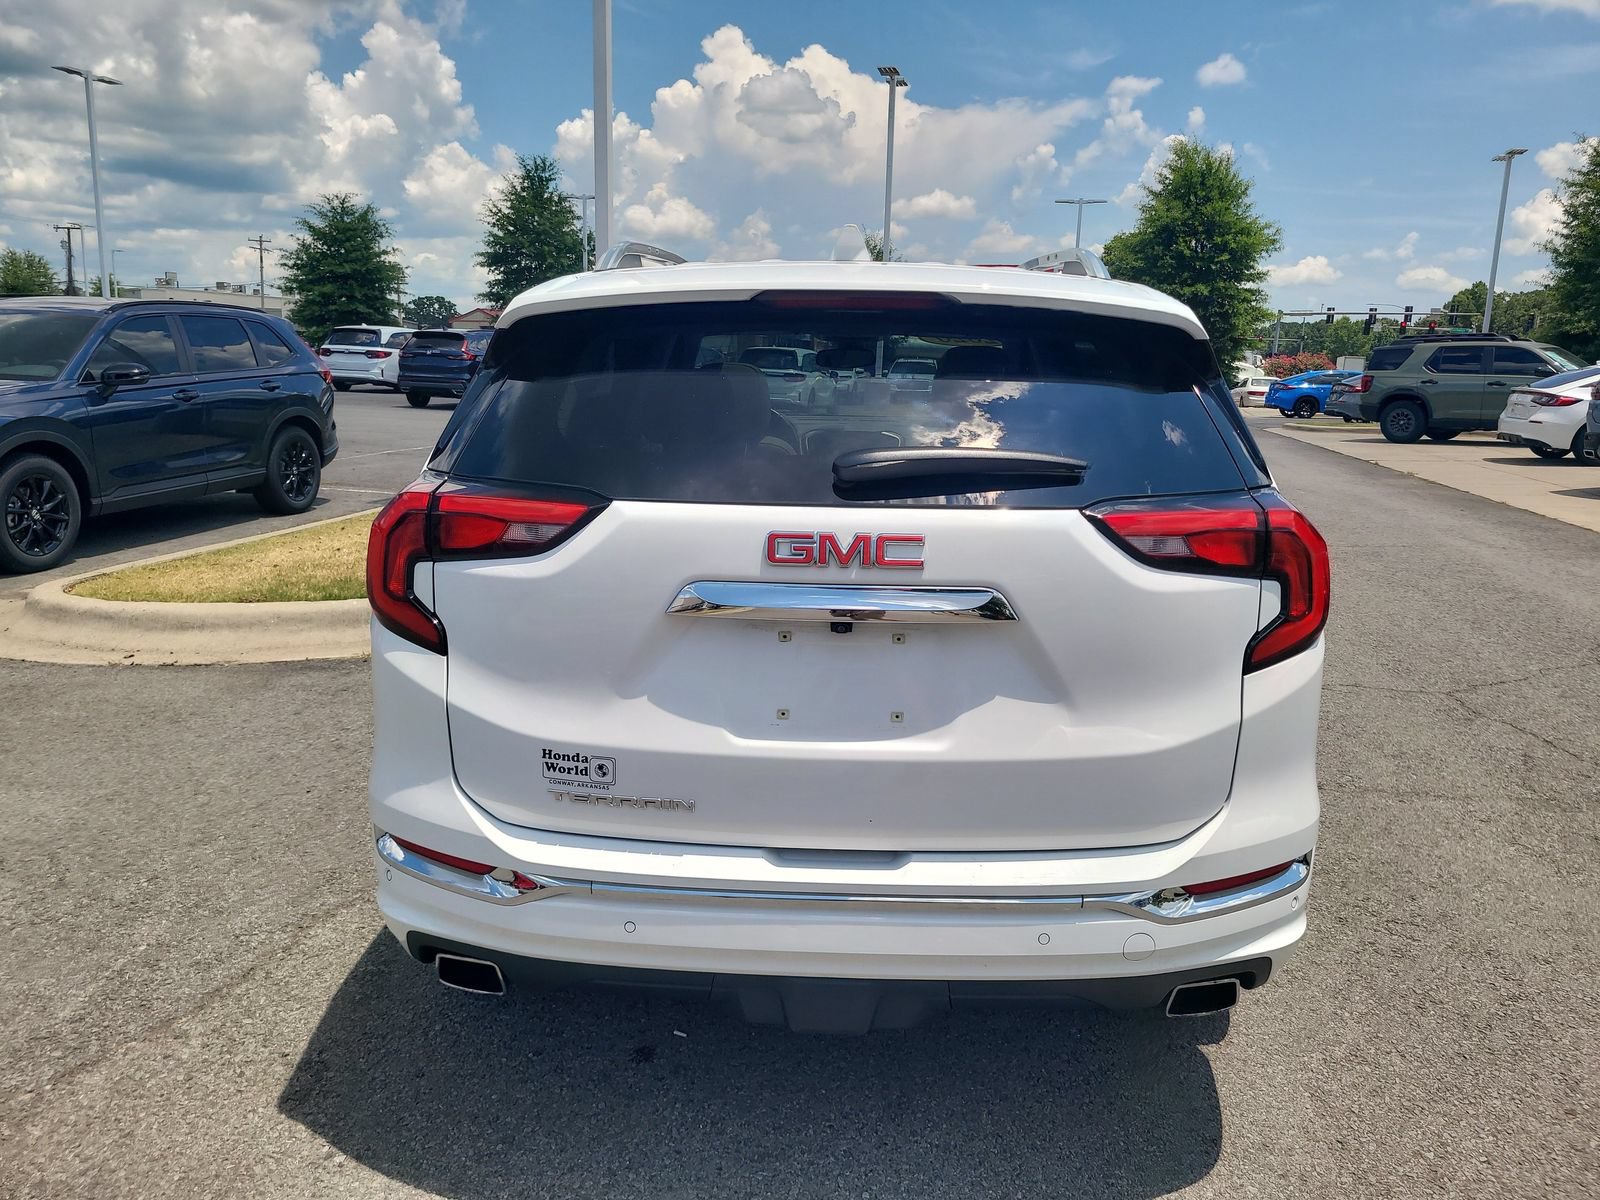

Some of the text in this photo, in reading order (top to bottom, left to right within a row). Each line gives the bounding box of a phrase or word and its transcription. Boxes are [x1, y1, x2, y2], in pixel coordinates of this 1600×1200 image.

[766, 530, 925, 570] GMC
[541, 748, 589, 764] Honda
[544, 761, 589, 777] World
[576, 782, 610, 791] ARKANSAS
[548, 789, 696, 813] TERRAIN
